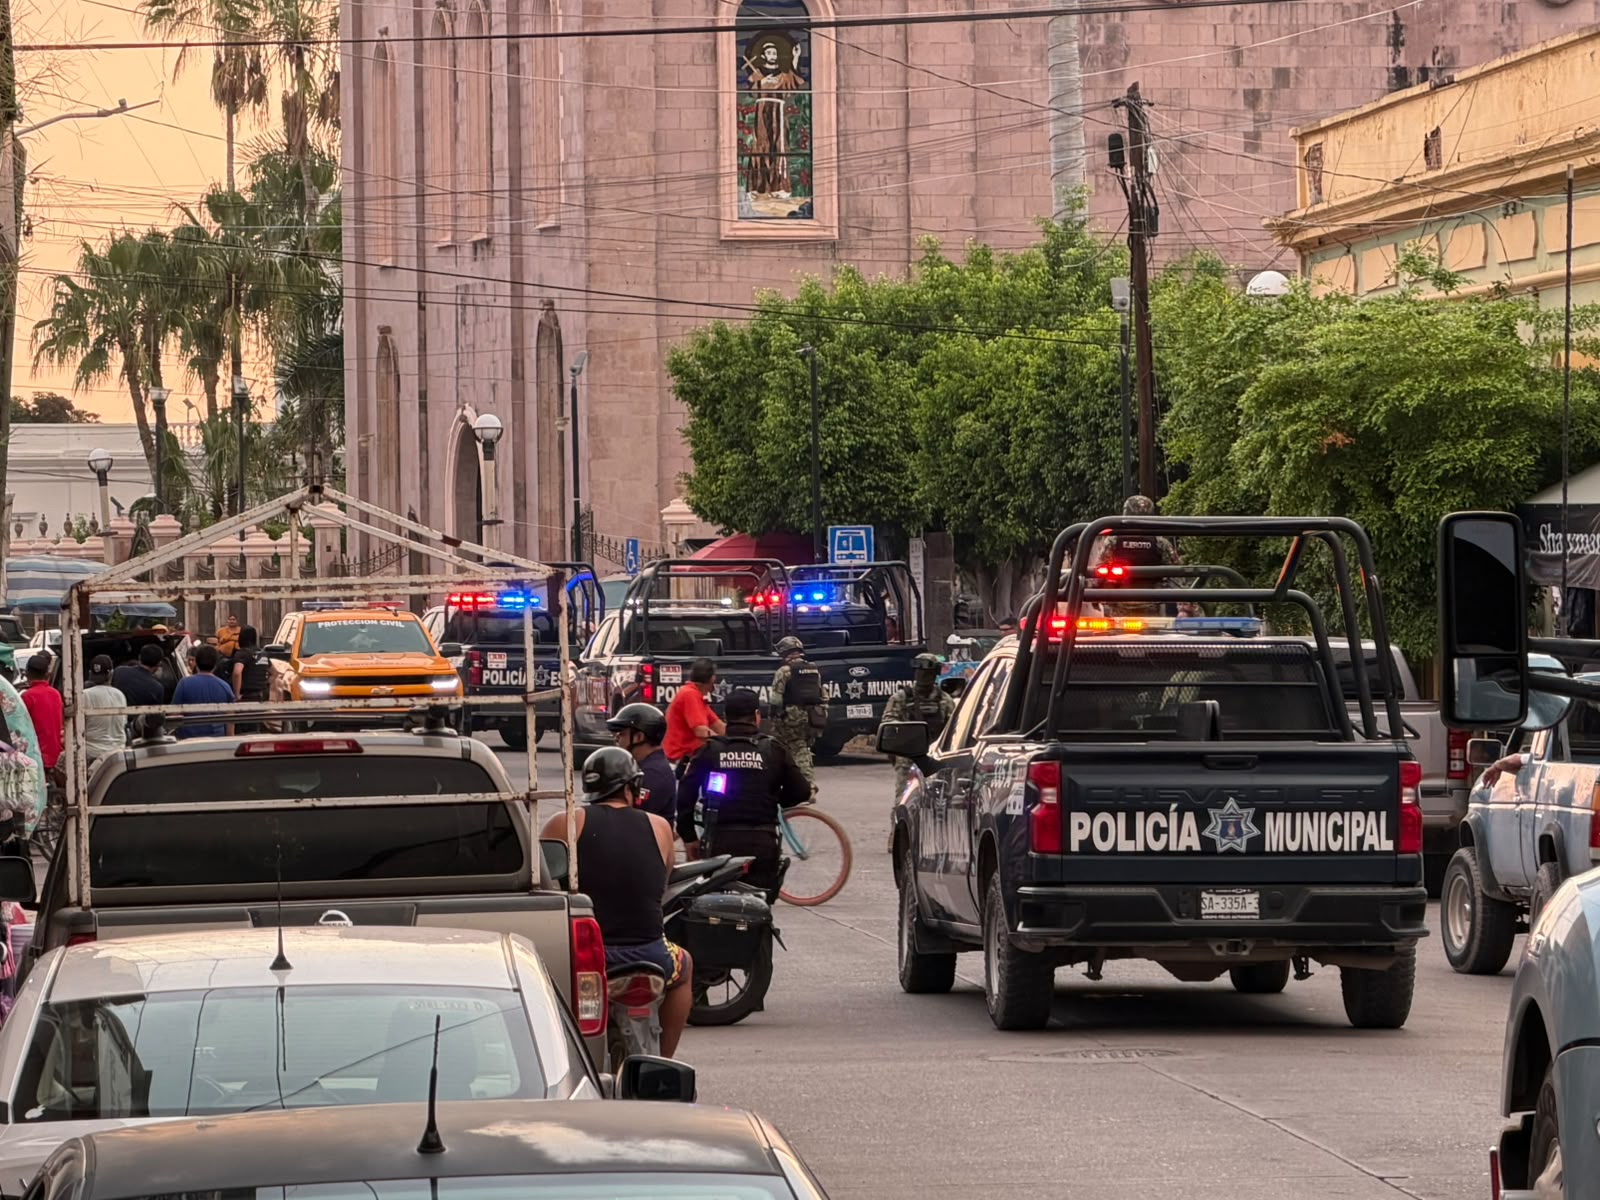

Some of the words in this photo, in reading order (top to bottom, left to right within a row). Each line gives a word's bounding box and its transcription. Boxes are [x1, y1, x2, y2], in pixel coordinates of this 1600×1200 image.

[379, 619, 405, 628] CIVIL
[720, 761, 763, 770] MUNICIPAL
[1070, 802, 1201, 853] POLICÍA
[1264, 811, 1394, 853] MUNICIPAL
